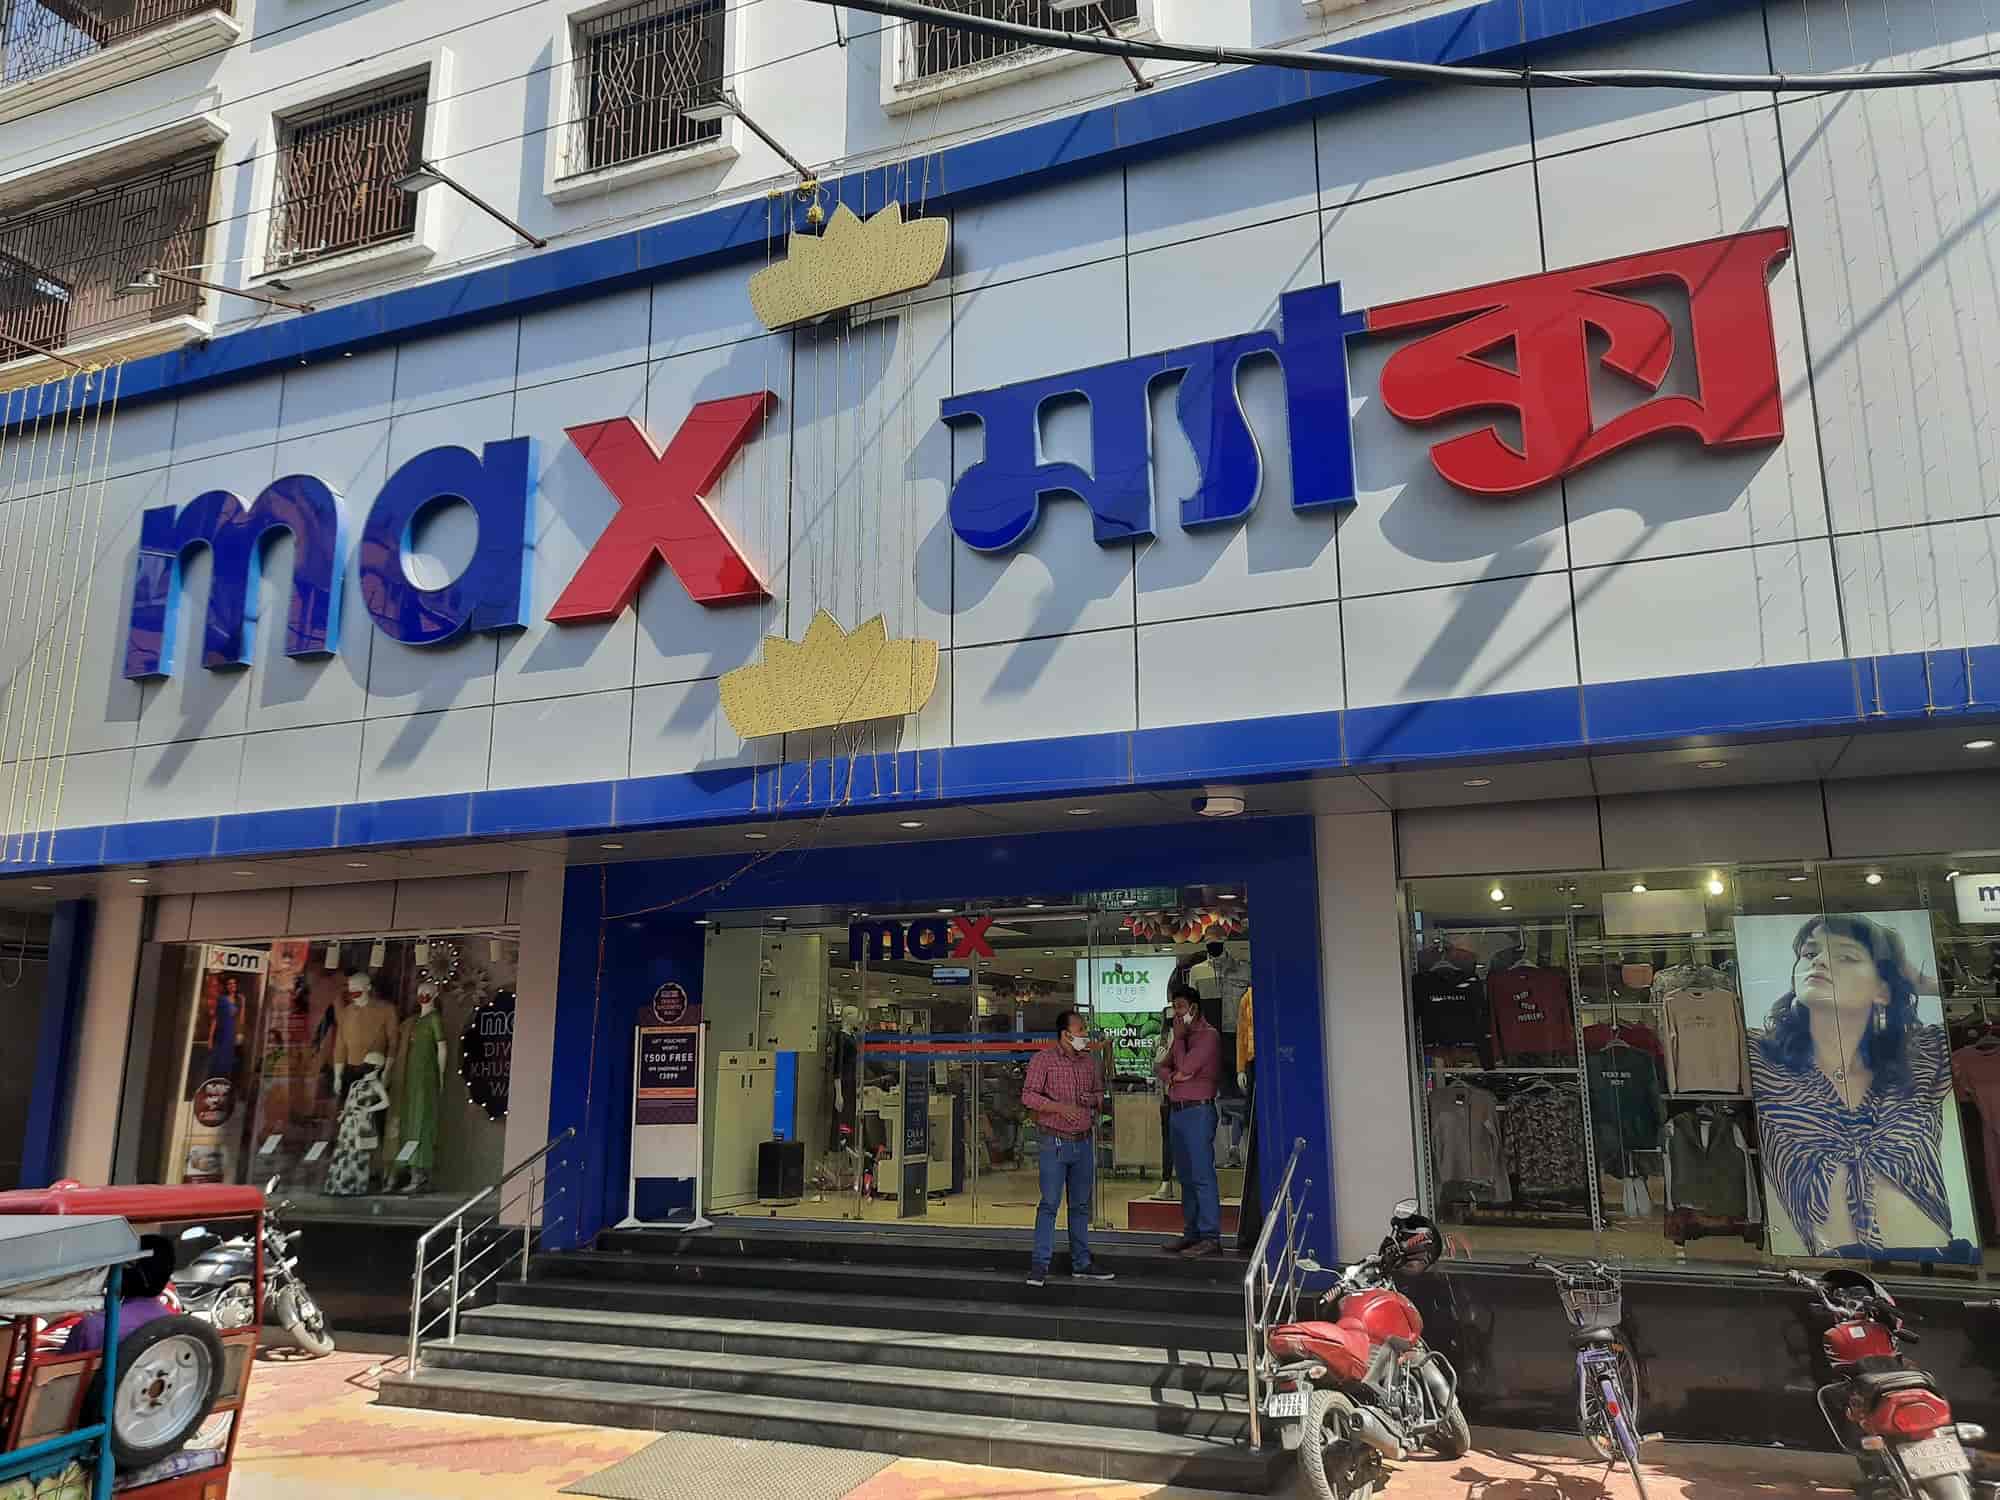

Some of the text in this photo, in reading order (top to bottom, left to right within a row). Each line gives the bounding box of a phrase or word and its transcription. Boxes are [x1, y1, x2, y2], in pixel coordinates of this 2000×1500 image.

[122, 390, 778, 681] max
[849, 915, 996, 960] max
[1102, 969, 1150, 985] max
[1103, 1027, 1137, 1039] SHION
[1119, 1038, 1153, 1048] CARES
[669, 1053, 694, 1062] FREE
